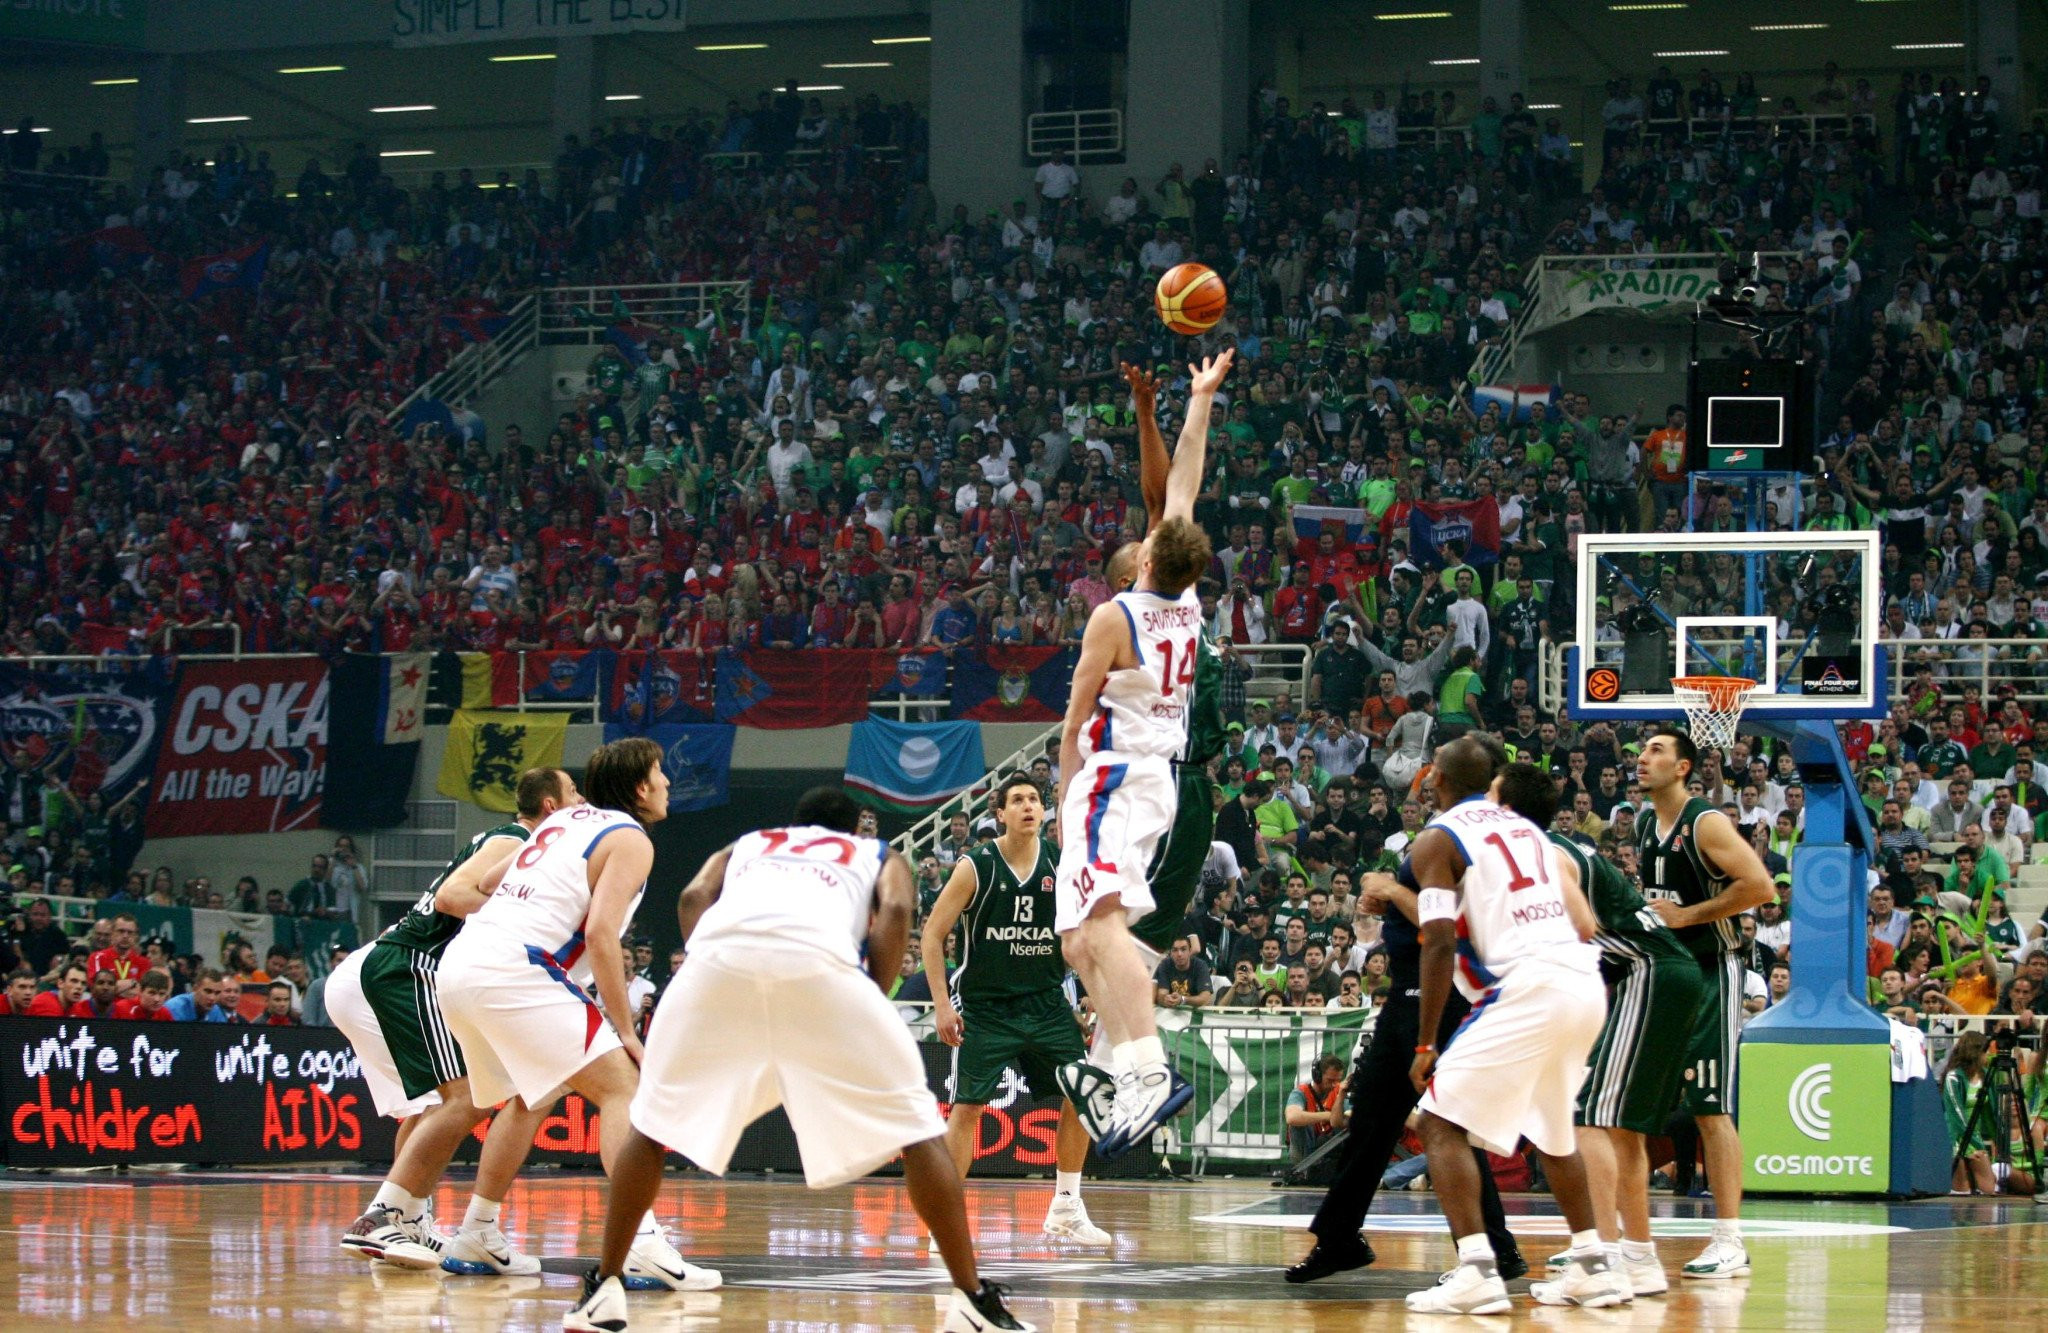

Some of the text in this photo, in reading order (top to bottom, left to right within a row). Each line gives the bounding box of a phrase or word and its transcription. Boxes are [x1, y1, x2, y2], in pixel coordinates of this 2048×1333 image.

[1155, 637, 1196, 697] 14
[173, 673, 330, 755] CSKA
[158, 763, 326, 802] All the Way!
[517, 827, 566, 870] 8
[1484, 828, 1549, 892] 17
[1072, 866, 1095, 908] 14
[1655, 856, 1666, 885] 11
[1013, 896, 1034, 922] 13
[1512, 901, 1564, 926] MOSCO
[986, 926, 1054, 940] NOKIA
[1010, 943, 1053, 956] Nseries
[23, 1025, 180, 1081] unite for
[216, 1034, 366, 1094] unite again
[1697, 1059, 1717, 1088] 11
[12, 1074, 202, 1154] children
[263, 1080, 362, 1151] AIDS
[1754, 1154, 1873, 1175] COSMOTE
